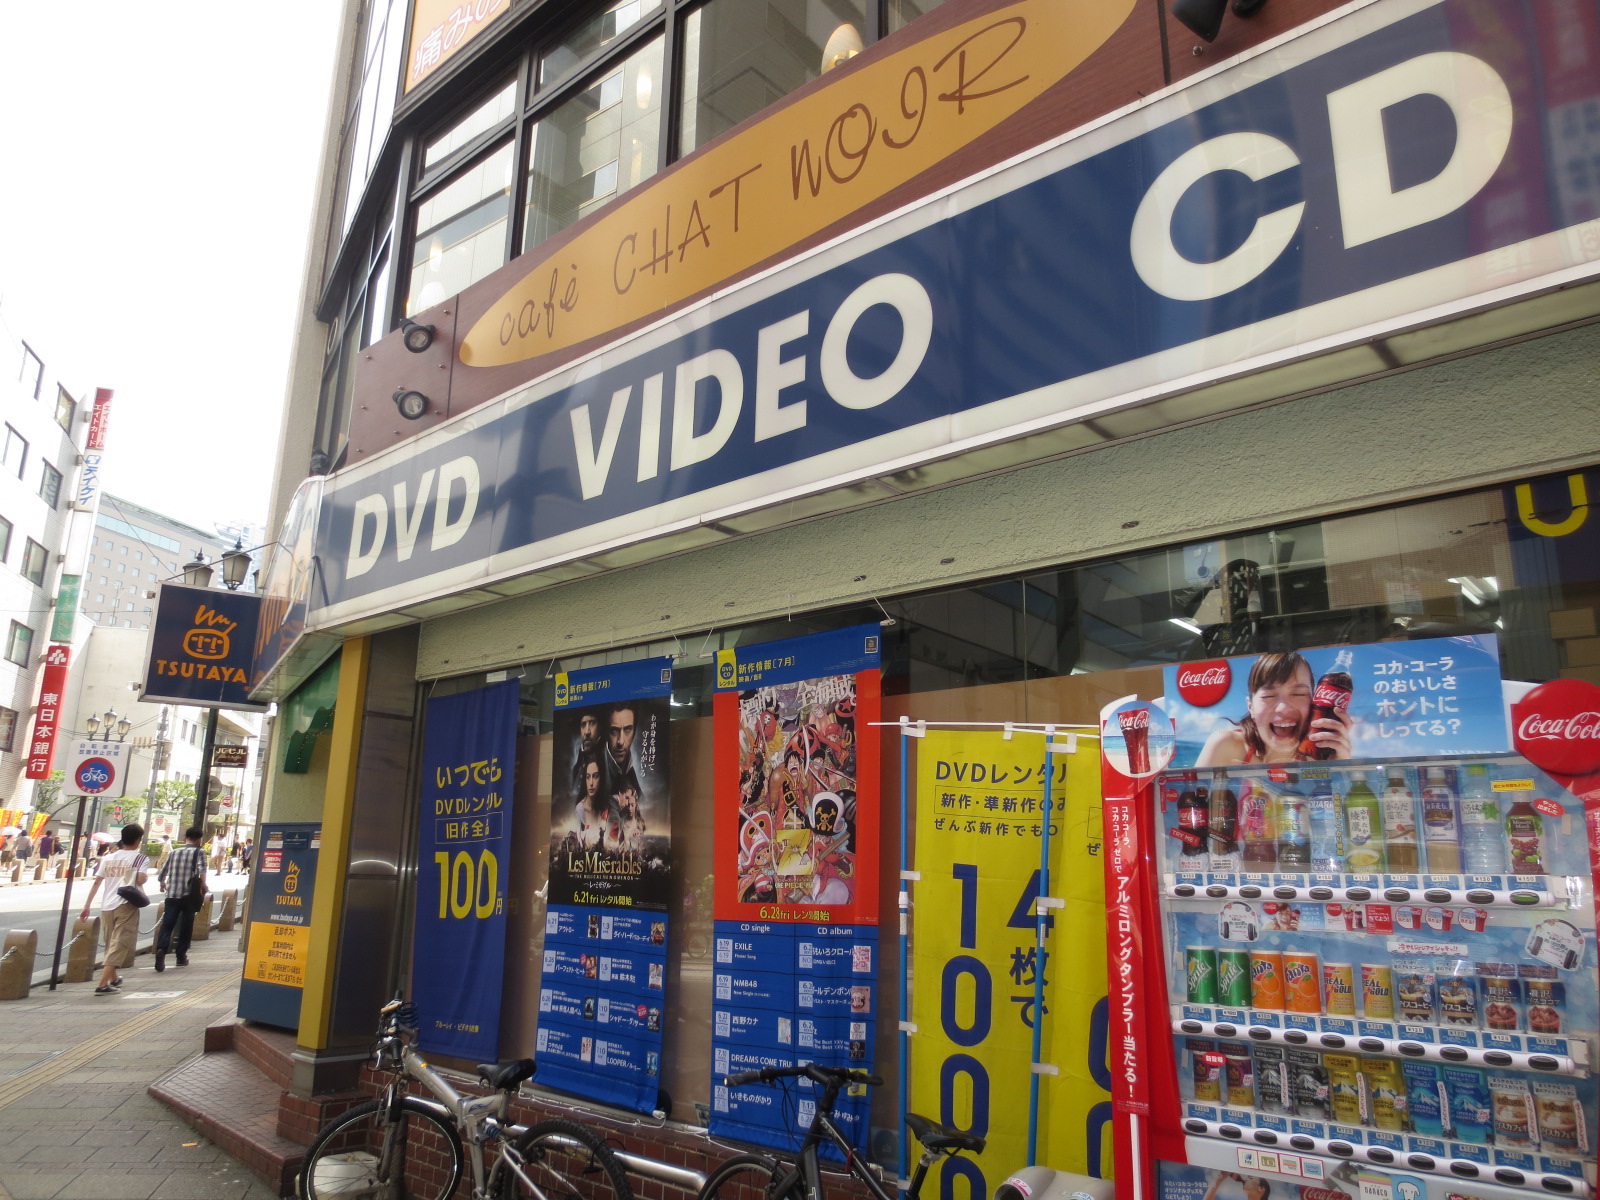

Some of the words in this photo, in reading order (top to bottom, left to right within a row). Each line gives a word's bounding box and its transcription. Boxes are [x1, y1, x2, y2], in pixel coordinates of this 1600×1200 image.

[612, 163, 762, 295] CHAT
[345, 455, 480, 580] DVD
[570, 272, 933, 501] VIDEO
[1130, 51, 1513, 301] CD
[156, 659, 247, 684] TSUTAYA
[1373, 656, 1454, 675] コカ・コーラ
[1179, 667, 1228, 688] Coca-Cola
[1374, 675, 1457, 694] のおいしさ
[1377, 696, 1459, 717] ホントに
[30, 693, 59, 773] 東日本銀行
[1518, 711, 1600, 741] Coca-Col
[436, 757, 502, 788] いつでも
[1172, 830, 1184, 838] TRY
[568, 851, 584, 873] Les
[585, 851, 642, 875] Misérables
[275, 895, 302, 906] TSUTAYA
[751, 925, 770, 933] single
[817, 927, 828, 935] CD
[830, 927, 853, 935] album
[733, 980, 758, 988] NMB48
[1188, 962, 1206, 991] Sprite
[1220, 964, 1237, 994] Sprite
[1325, 977, 1344, 986] REAL
[1334, 985, 1352, 994] GOLD
[1370, 987, 1389, 995] GOLD
[732, 1016, 758, 1025] 西野カナ
[731, 1054, 759, 1063] DREAMS
[760, 1057, 777, 1066] COME
[730, 1092, 772, 1105] いきものがかり
[1364, 1186, 1388, 1197] nanaco
